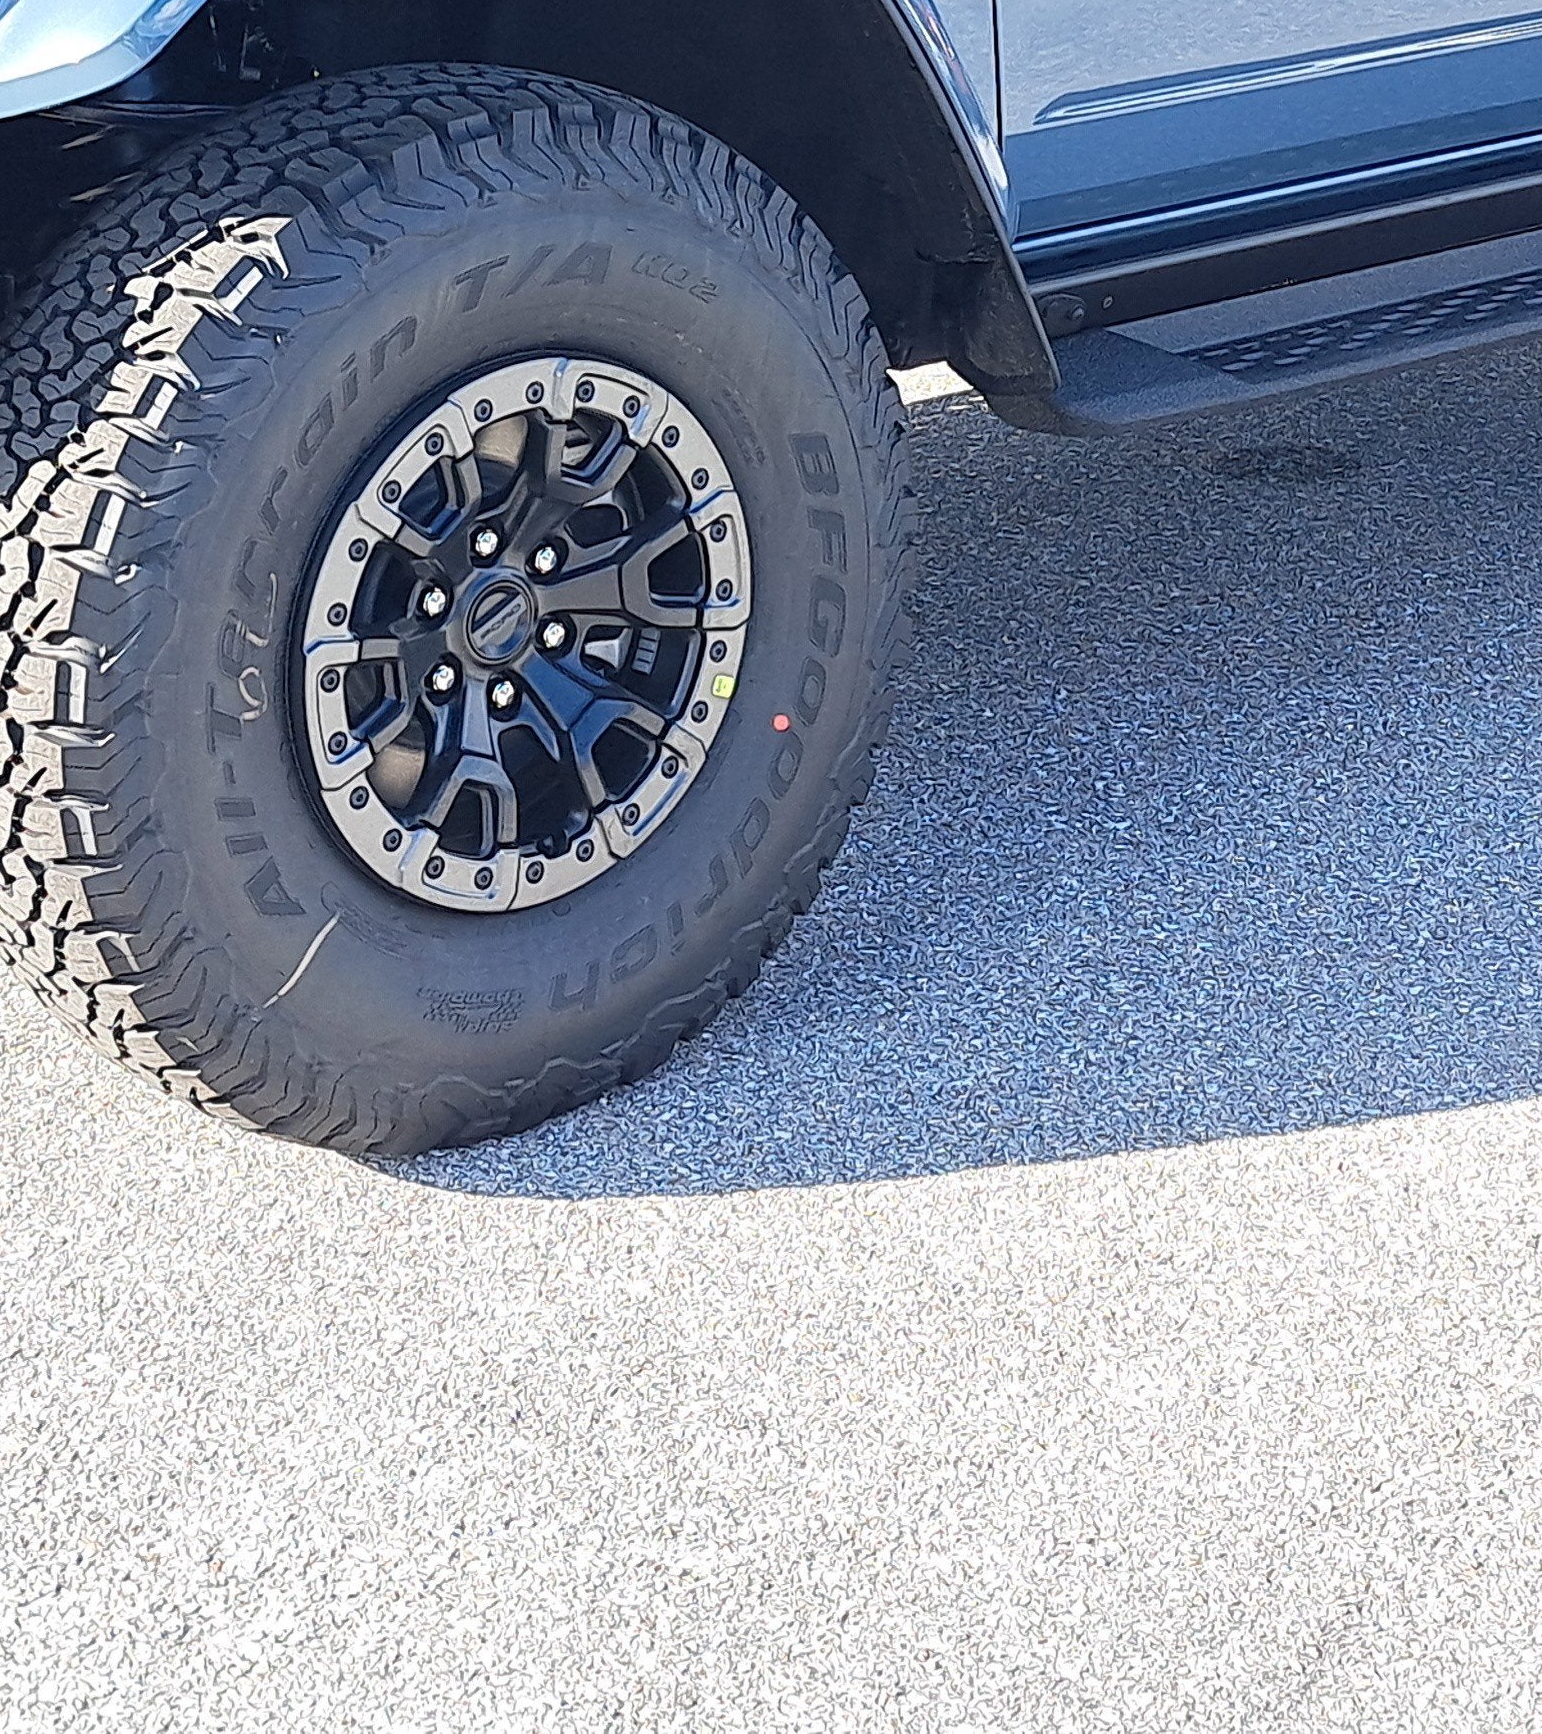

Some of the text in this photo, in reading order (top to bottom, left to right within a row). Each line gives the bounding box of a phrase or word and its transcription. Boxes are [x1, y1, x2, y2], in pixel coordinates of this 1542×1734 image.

[205, 314, 417, 916] All-Terrain
[455, 241, 614, 314] T/A
[548, 431, 847, 1012] BFGoodrich
